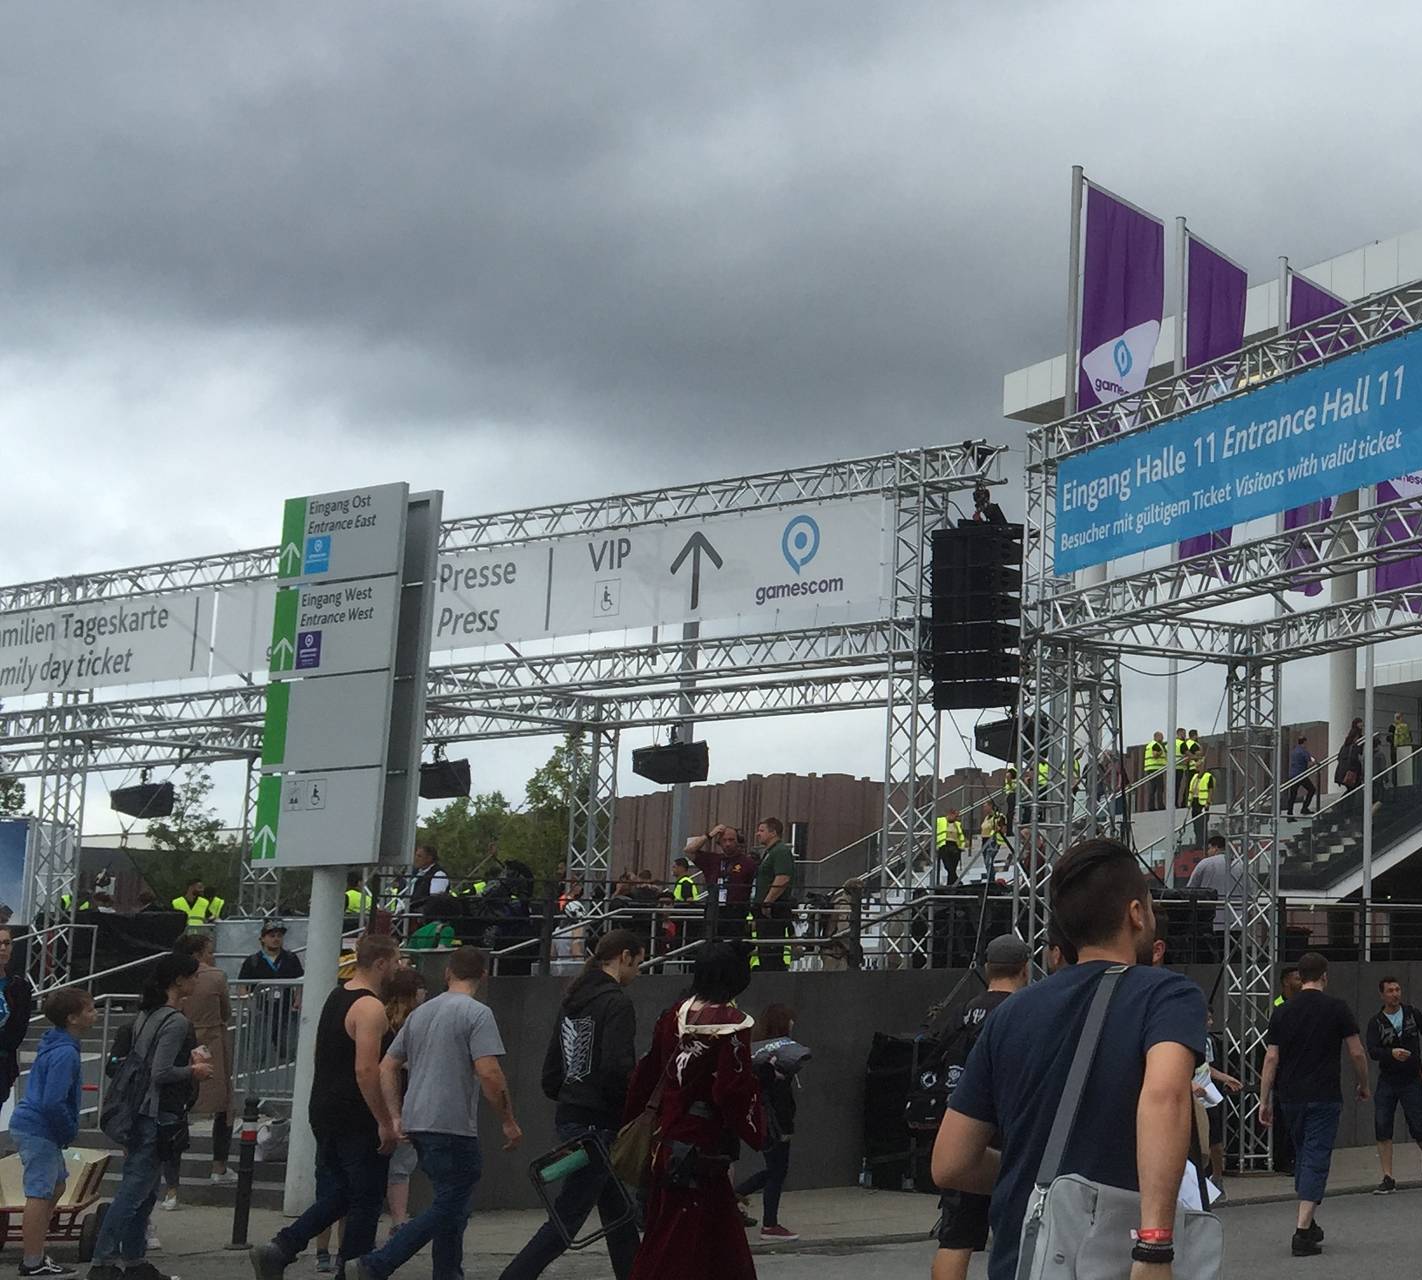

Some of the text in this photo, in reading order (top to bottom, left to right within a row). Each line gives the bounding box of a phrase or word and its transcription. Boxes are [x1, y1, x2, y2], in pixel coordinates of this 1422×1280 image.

[1062, 364, 1405, 512] Eingang Halle 11 Entrance Hall 11
[1061, 428, 1402, 551] Besucher mit gültigem Ticket Visitors with valid ticket
[309, 495, 372, 516] Eingang Ost
[308, 514, 377, 535] Entrance East
[588, 537, 632, 572] VIP
[439, 562, 517, 592] Presse
[755, 577, 844, 606] gamescom
[301, 586, 373, 609] Eingang West
[0, 605, 169, 648] milien Tageskarte
[300, 607, 374, 627] Entrance West
[437, 607, 500, 637] Press
[40, 652, 75, 688] day
[77, 648, 134, 677] ticket
